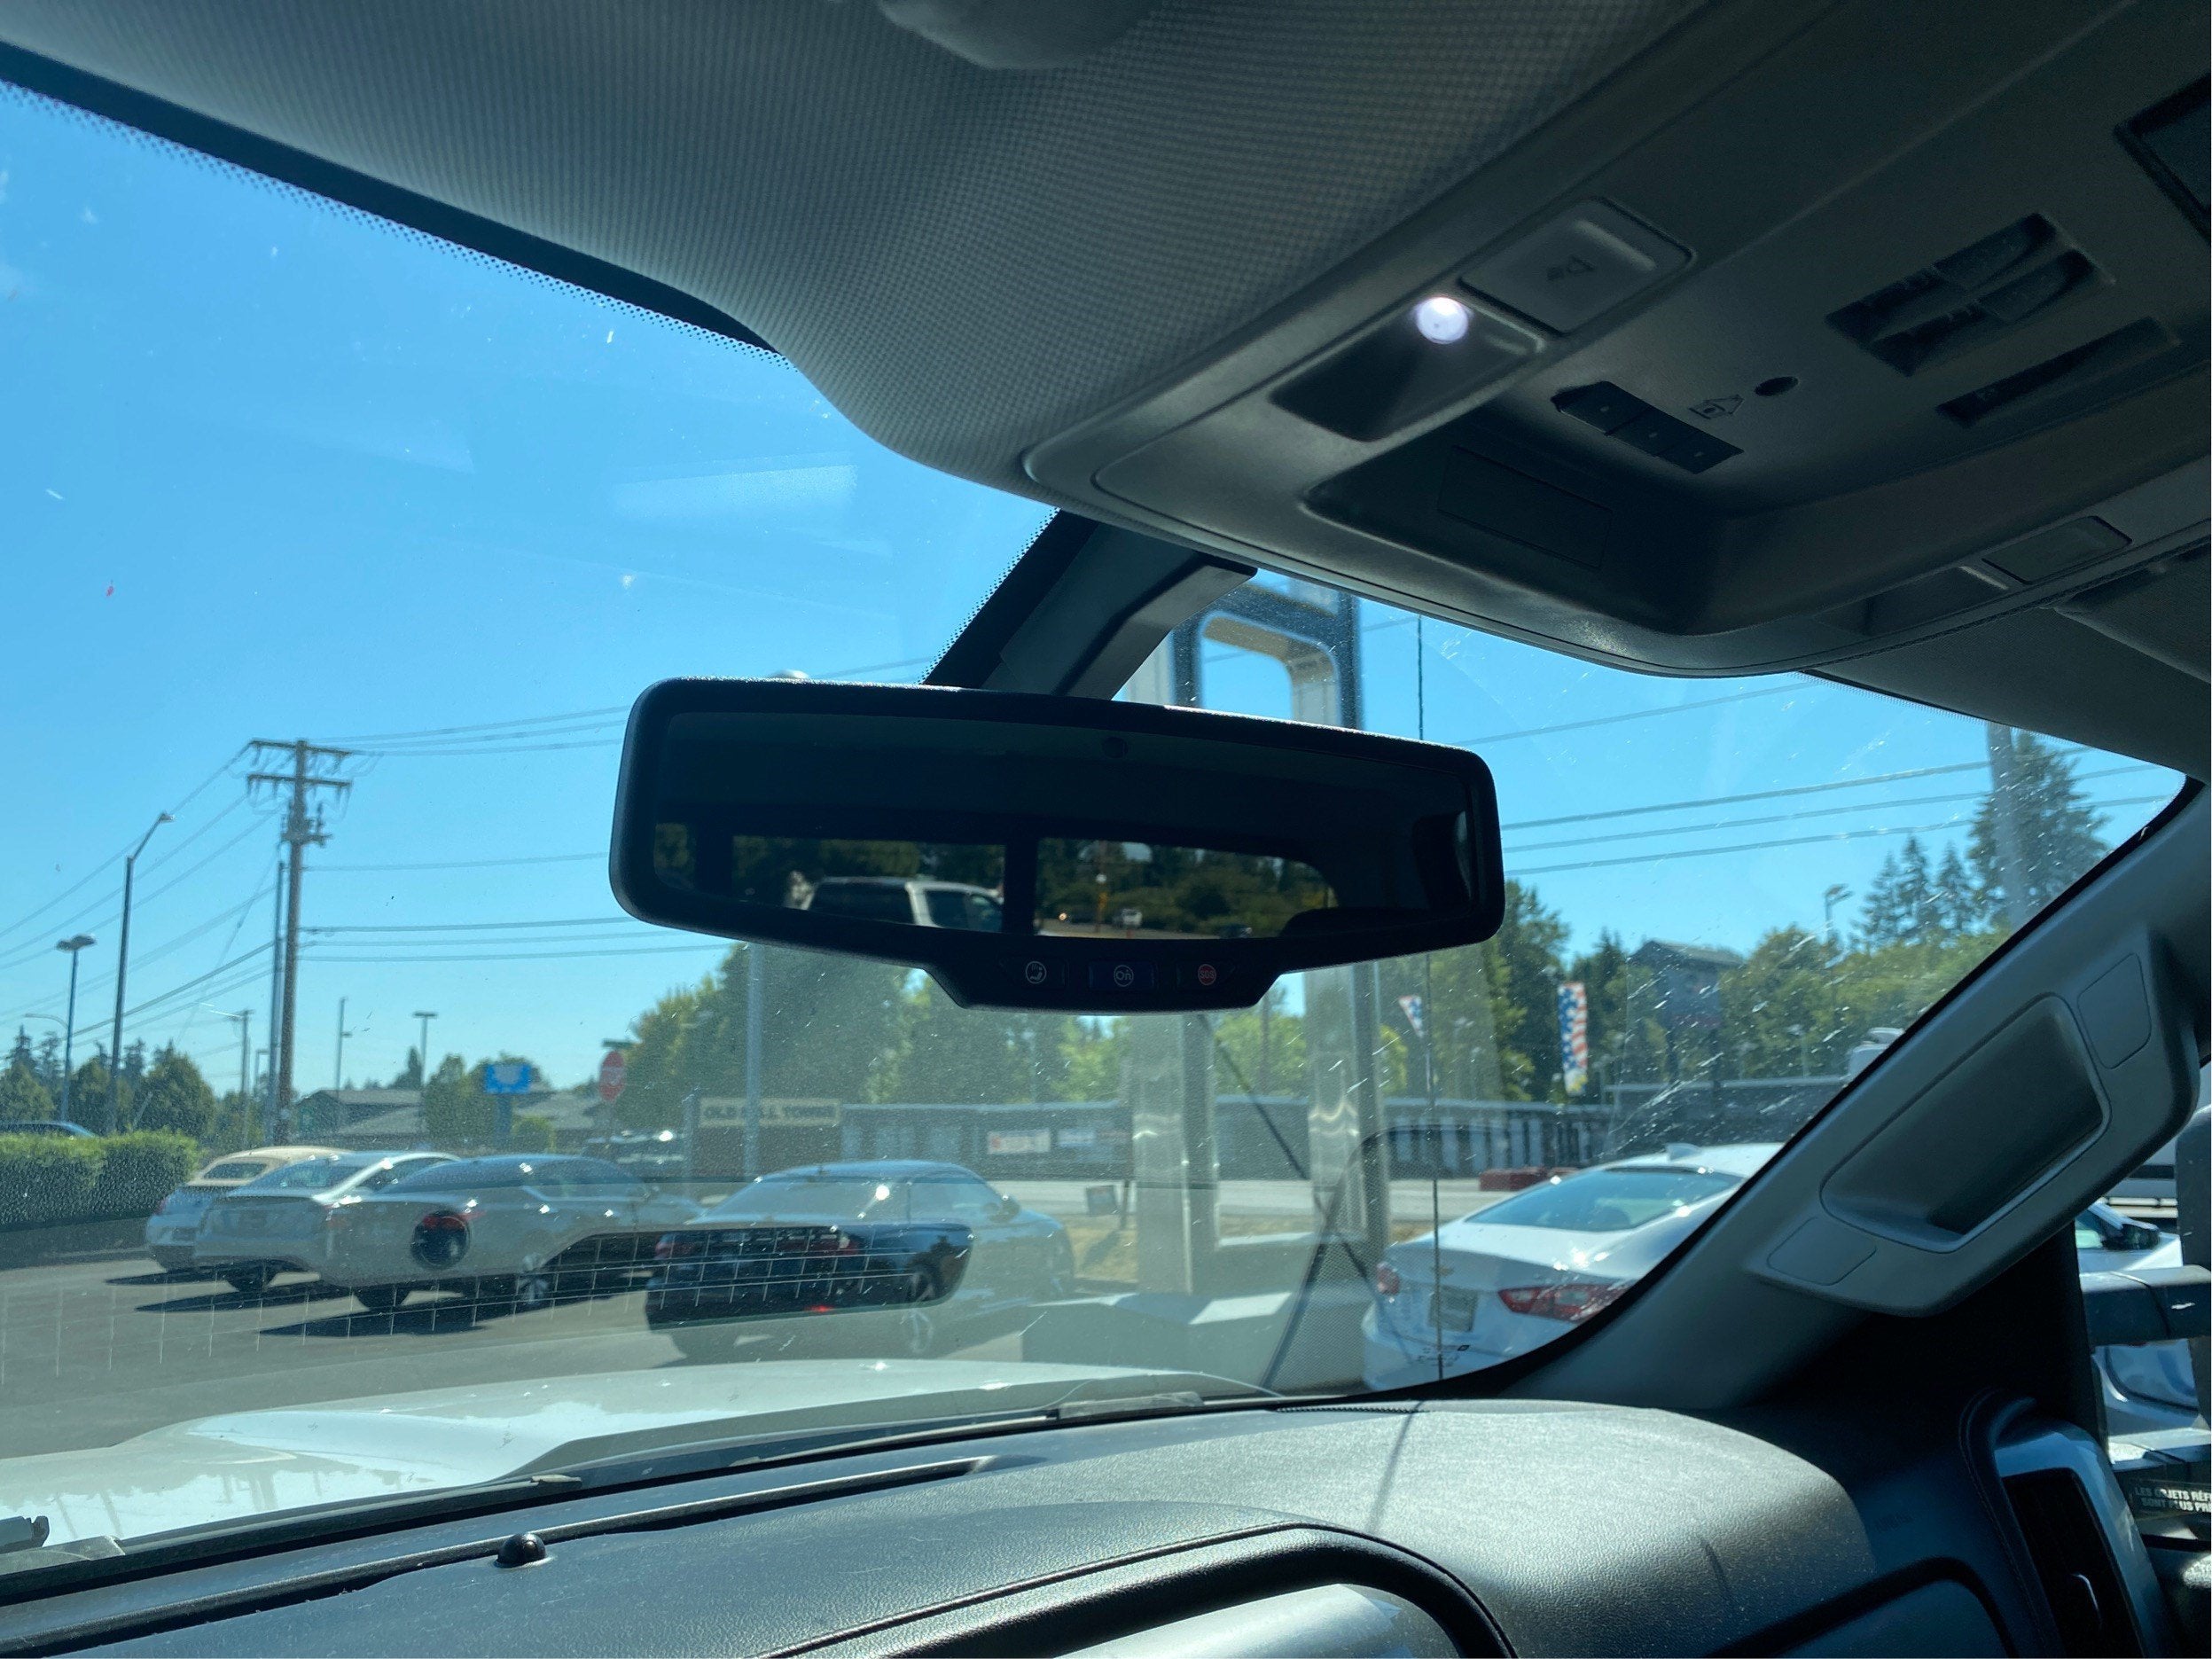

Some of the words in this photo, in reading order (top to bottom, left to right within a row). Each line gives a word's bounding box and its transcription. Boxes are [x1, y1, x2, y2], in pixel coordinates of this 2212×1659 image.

[1116, 969, 1132, 981] On
[2154, 1488, 2190, 1501] OBJETS
[2191, 1490, 2211, 1501] RÉF
[2169, 1499, 2194, 1511] PLUS
